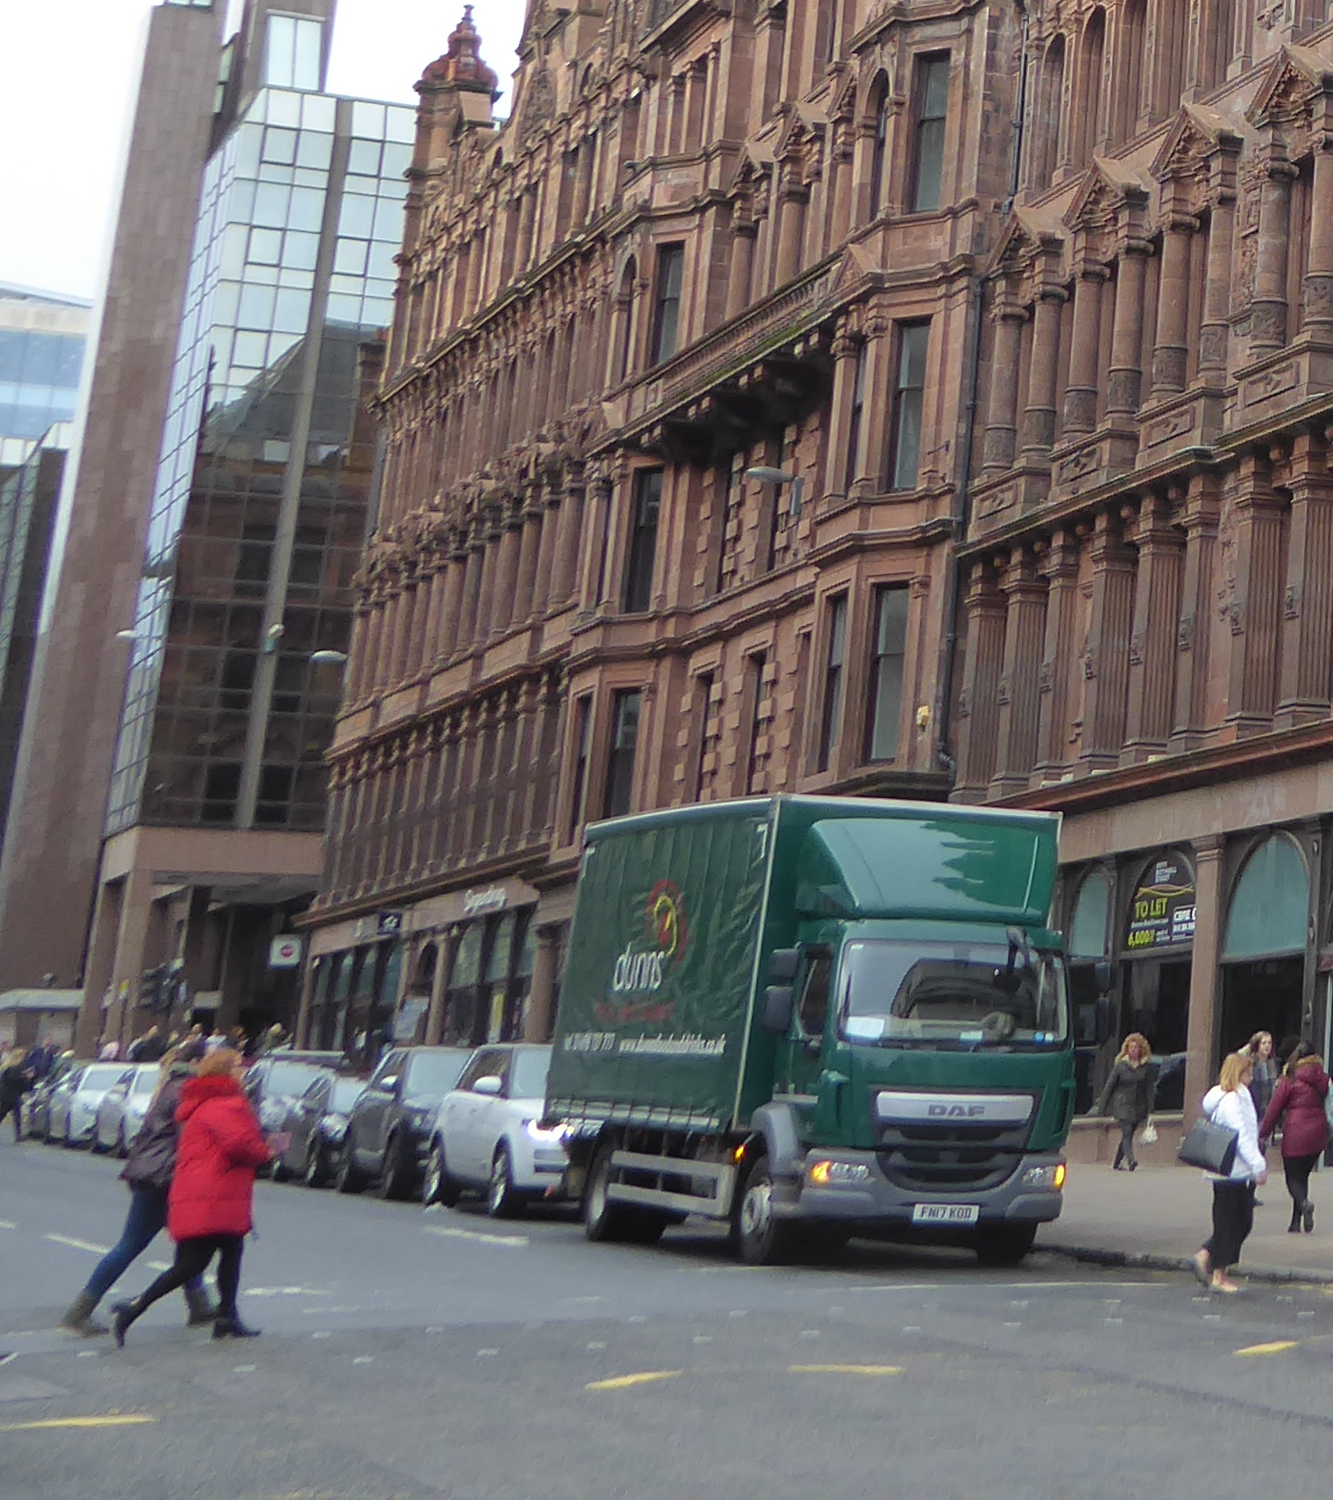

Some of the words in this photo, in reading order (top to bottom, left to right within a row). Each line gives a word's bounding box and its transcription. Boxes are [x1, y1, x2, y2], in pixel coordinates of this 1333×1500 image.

[1135, 901, 1149, 918] TO
[1151, 897, 1168, 916] LET
[613, 941, 665, 992] dunns
[928, 1104, 985, 1117] DAF
